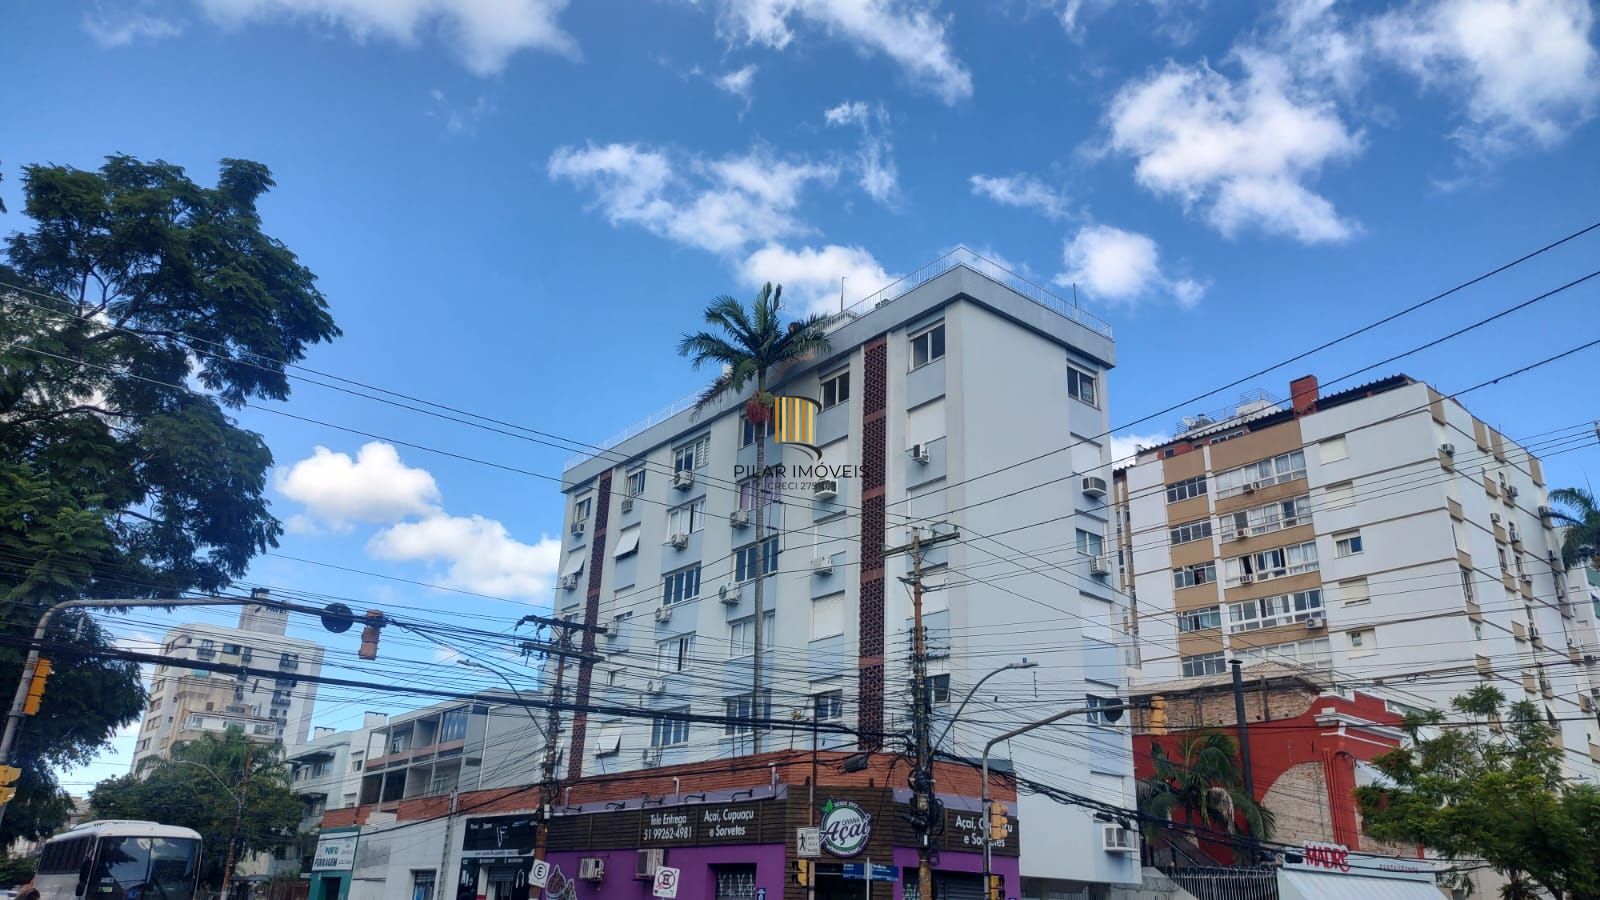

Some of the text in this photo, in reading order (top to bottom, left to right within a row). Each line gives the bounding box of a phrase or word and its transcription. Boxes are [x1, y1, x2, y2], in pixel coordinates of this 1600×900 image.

[651, 812, 687, 827] Tele Entrega
[723, 809, 753, 823] Cupuaçu
[653, 826, 692, 840] 99262-4981
[709, 825, 745, 837] e Sorvetes
[963, 835, 970, 844] e
